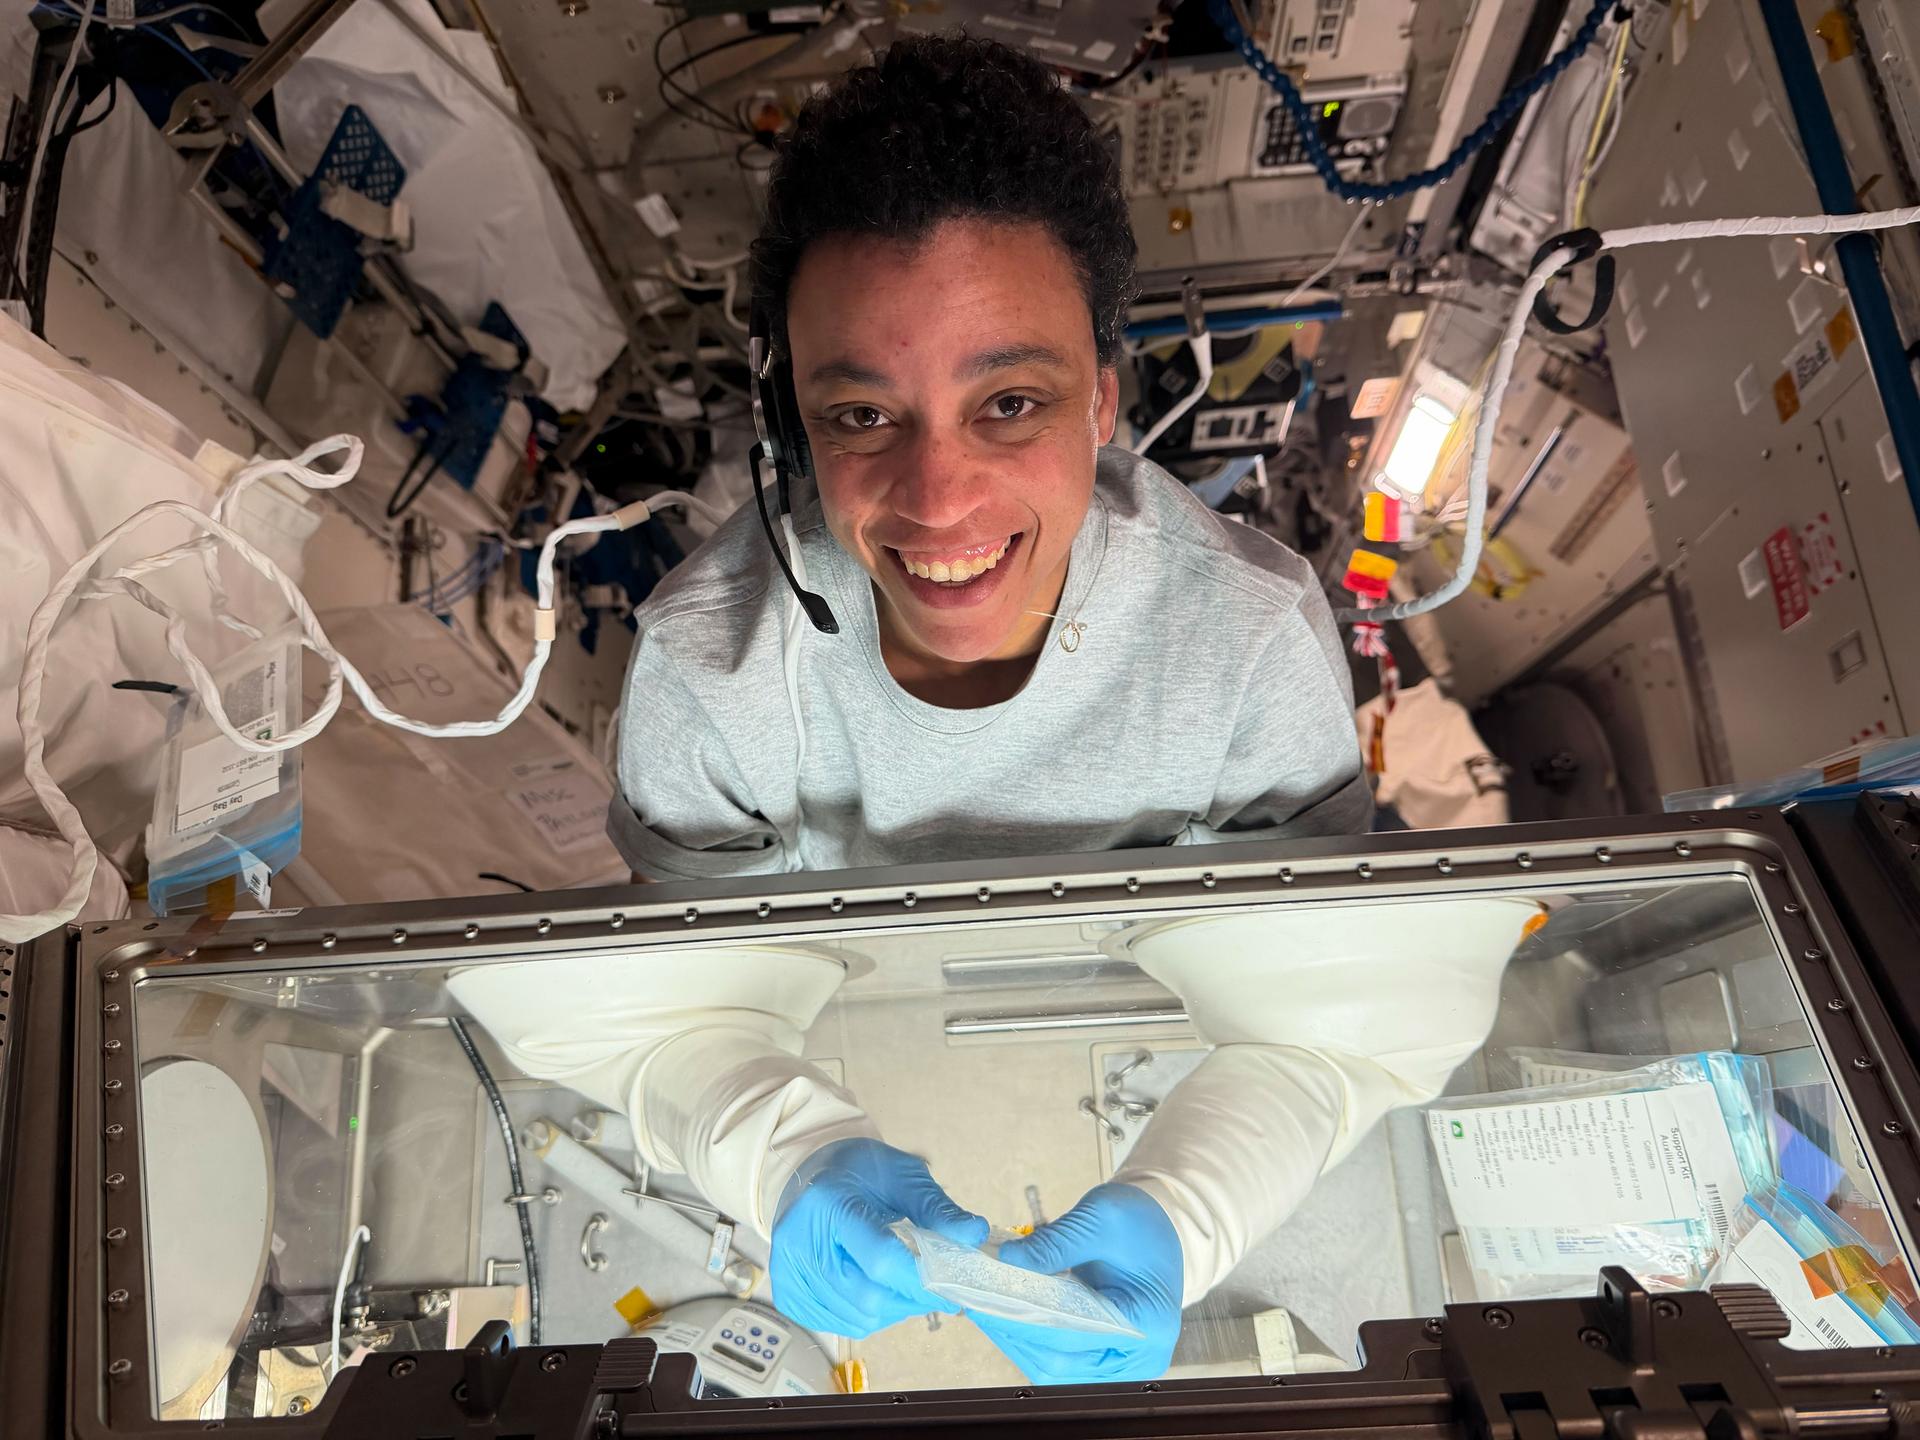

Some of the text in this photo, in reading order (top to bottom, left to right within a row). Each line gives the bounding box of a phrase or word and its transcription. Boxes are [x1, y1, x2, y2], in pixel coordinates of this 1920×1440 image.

[212, 795, 243, 811] Day Bag
[1671, 1127, 1692, 1179] Support Kit
